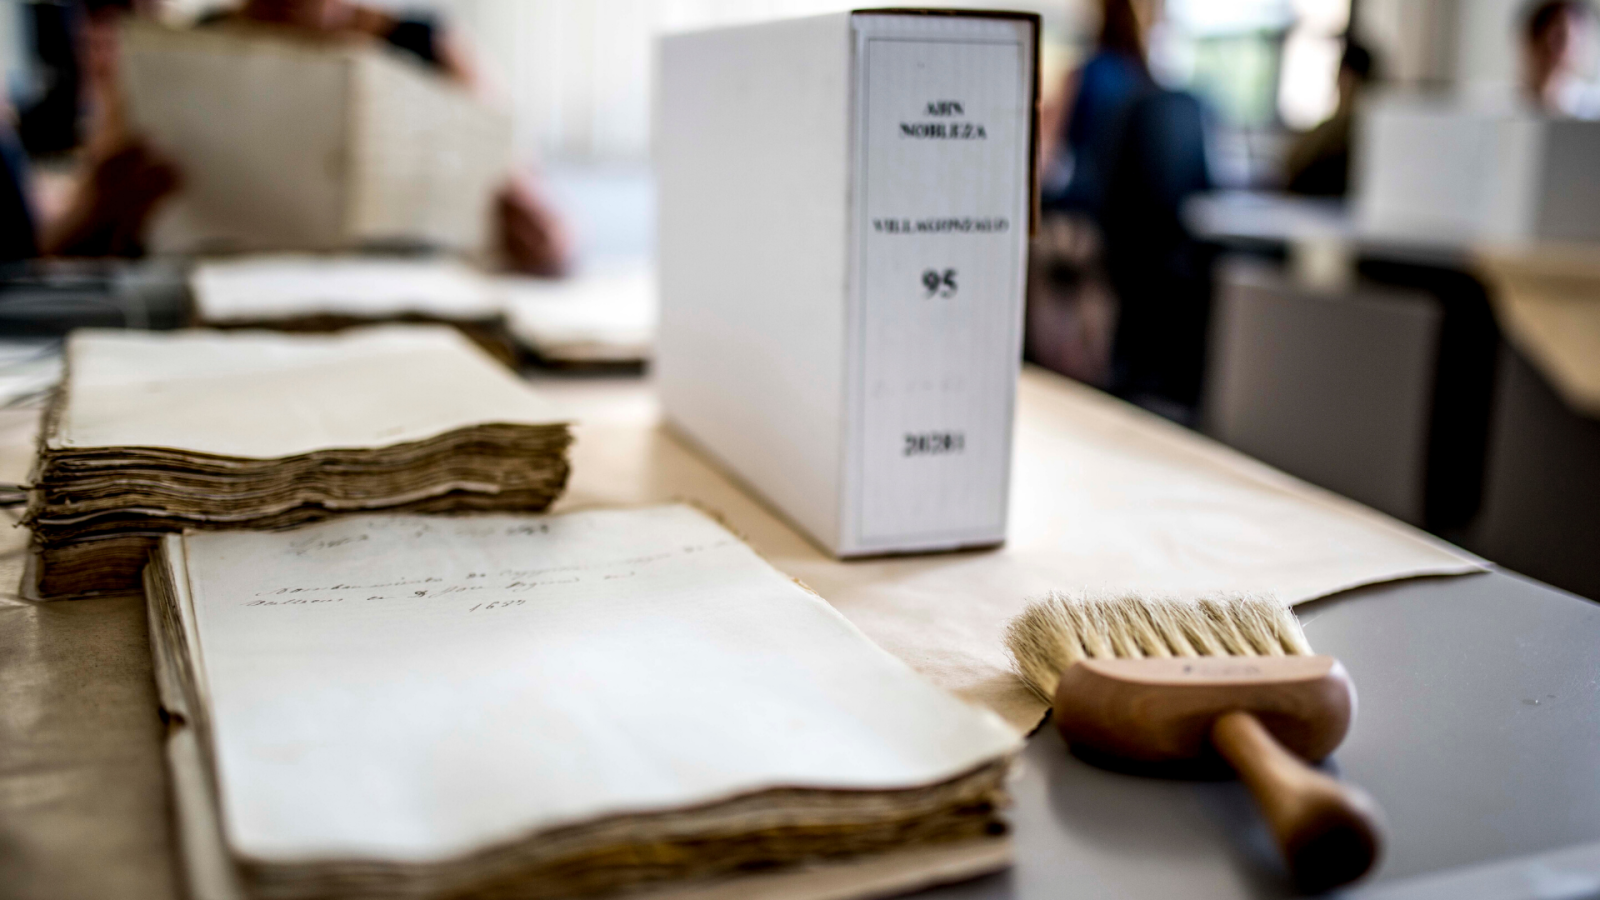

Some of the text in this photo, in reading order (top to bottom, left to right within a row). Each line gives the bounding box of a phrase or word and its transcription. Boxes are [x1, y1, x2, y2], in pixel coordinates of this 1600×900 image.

[899, 121, 988, 140] NOBLEZA
[872, 217, 1010, 234] VILLAGONZALO
[921, 268, 959, 299] 95
